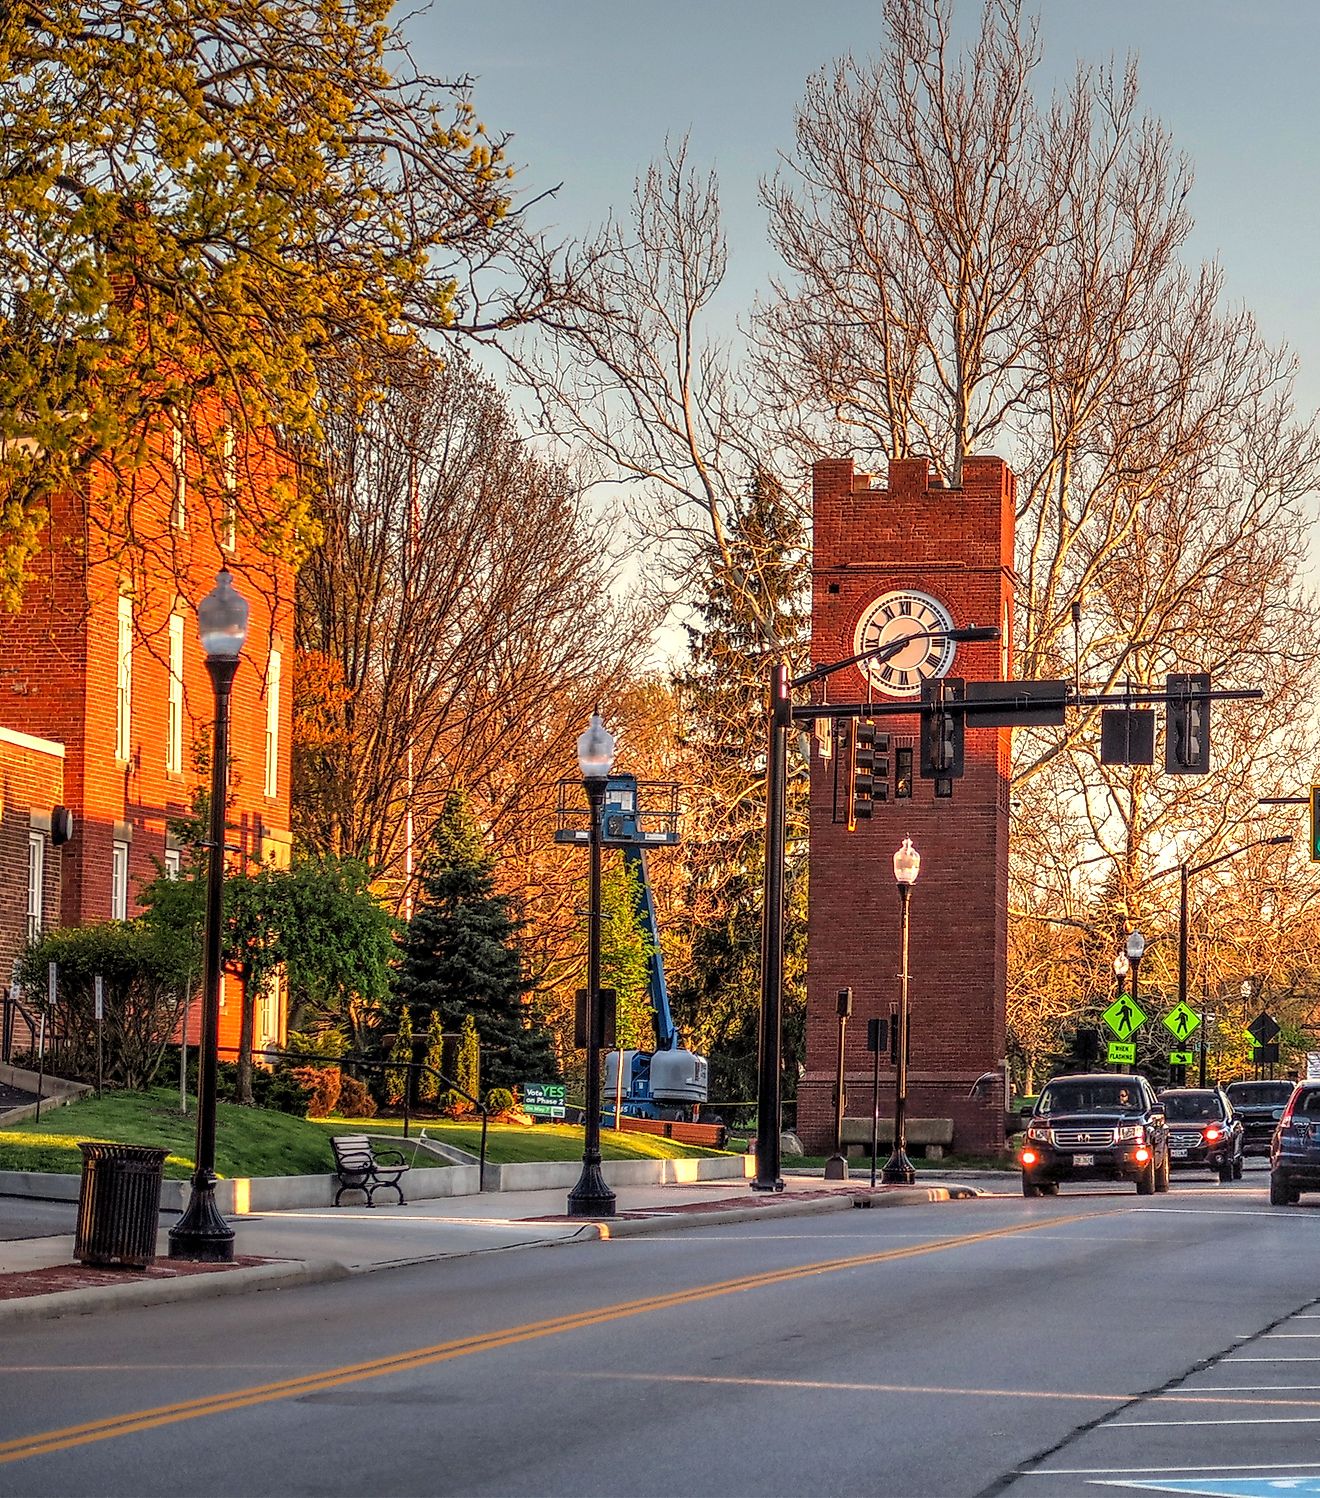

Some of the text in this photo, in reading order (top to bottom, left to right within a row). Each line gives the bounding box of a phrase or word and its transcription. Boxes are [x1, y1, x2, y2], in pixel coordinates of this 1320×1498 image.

[526, 1085, 565, 1098] Vote YES
[536, 1096, 558, 1105] Phase
[558, 1098, 564, 1106] 2
